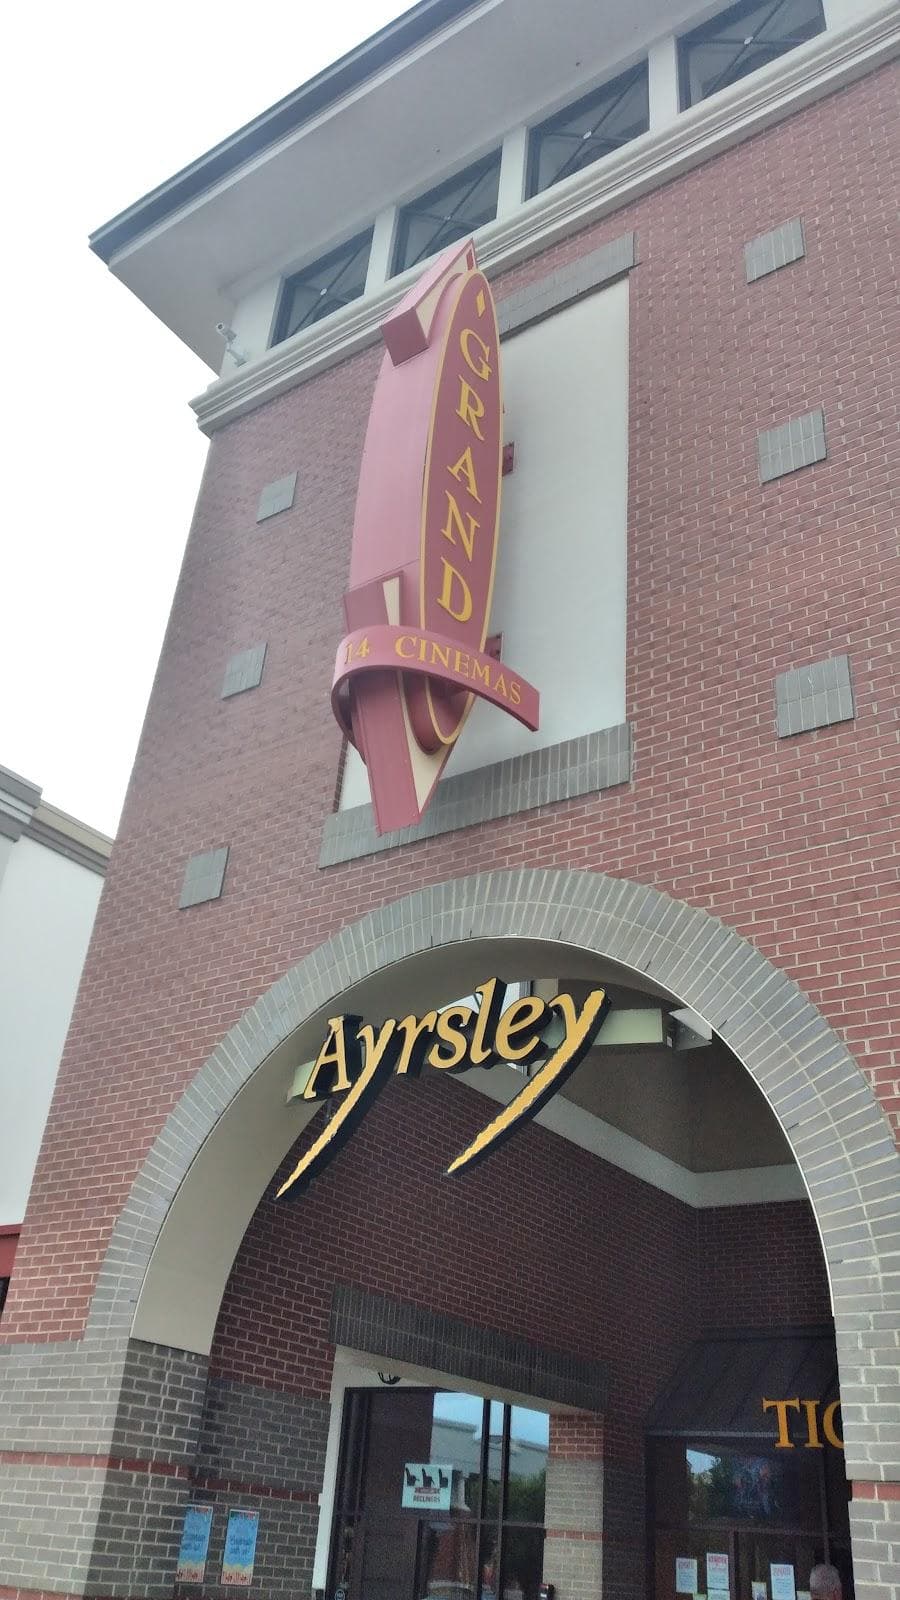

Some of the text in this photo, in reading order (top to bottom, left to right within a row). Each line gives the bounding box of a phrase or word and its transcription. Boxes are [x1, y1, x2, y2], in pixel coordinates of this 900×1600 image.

[437, 328, 492, 623] GRAND
[344, 635, 521, 705] 14 CINEMAS
[275, 977, 605, 1199] Ayrsley
